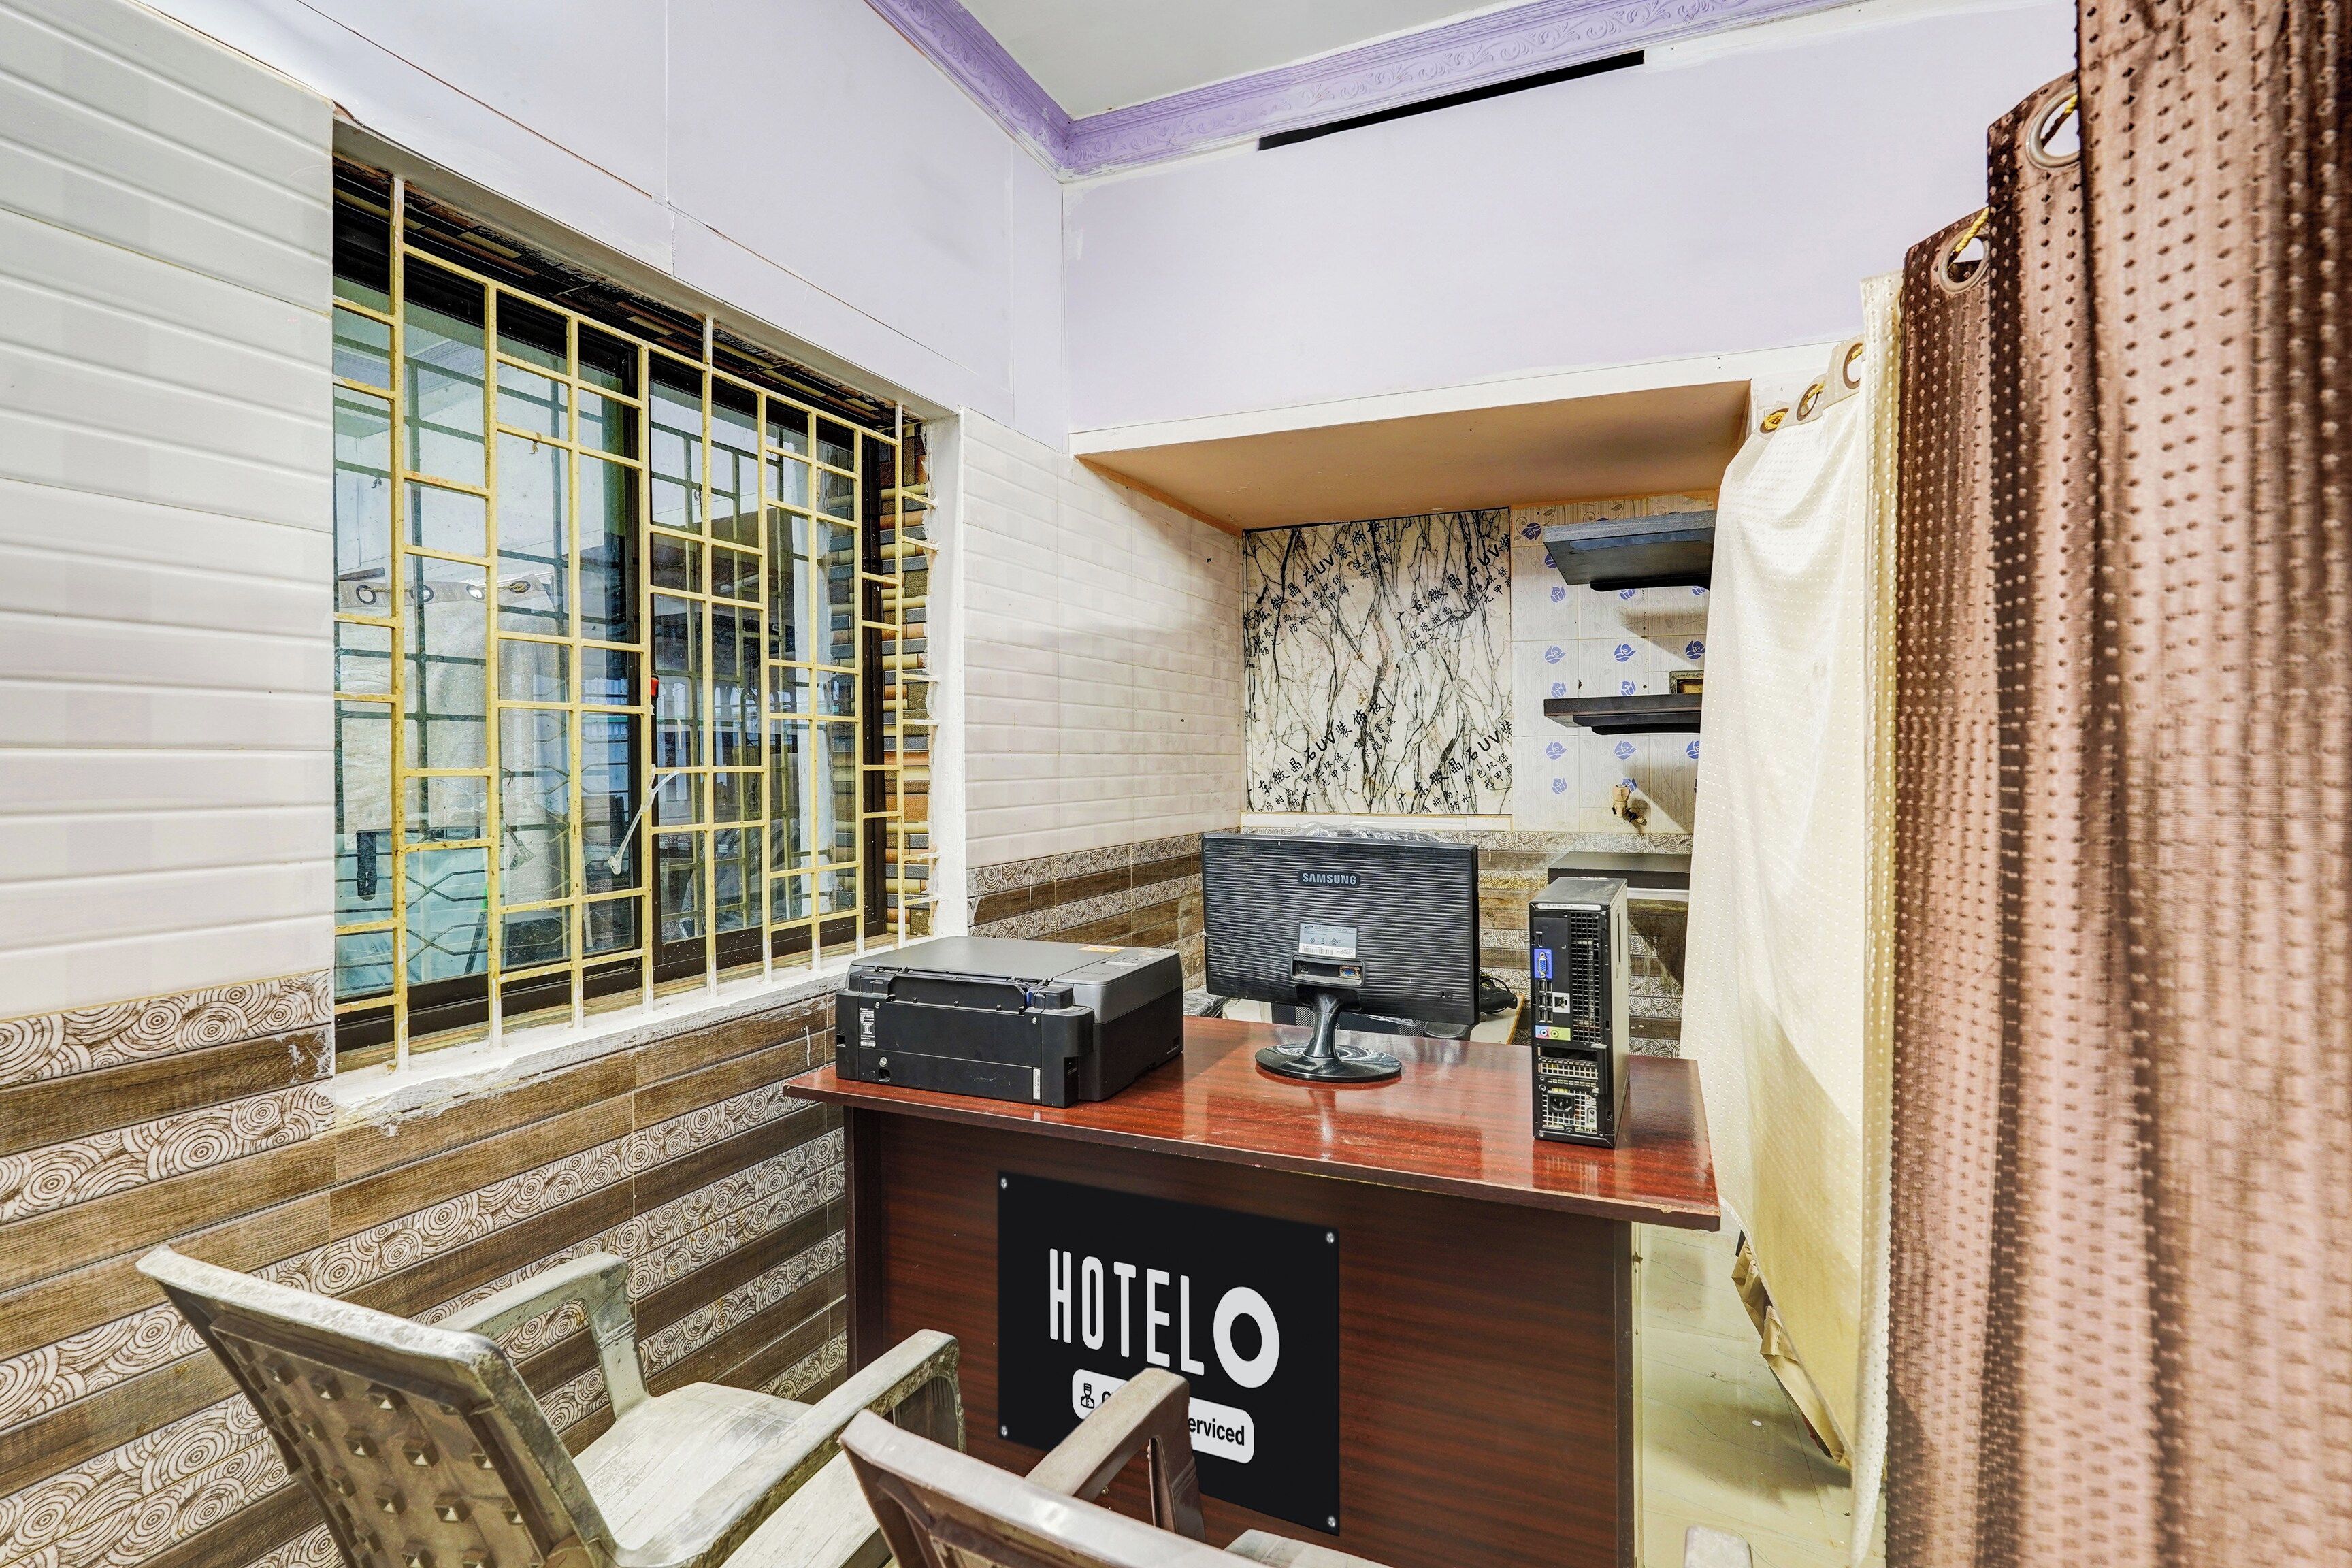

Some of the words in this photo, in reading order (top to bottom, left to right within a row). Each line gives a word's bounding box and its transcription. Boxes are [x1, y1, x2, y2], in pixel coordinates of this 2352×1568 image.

[1302, 872, 1356, 885] SAMSUNG
[1049, 1247, 1205, 1376] HOTEL
[1188, 1418, 1245, 1446] erviced
